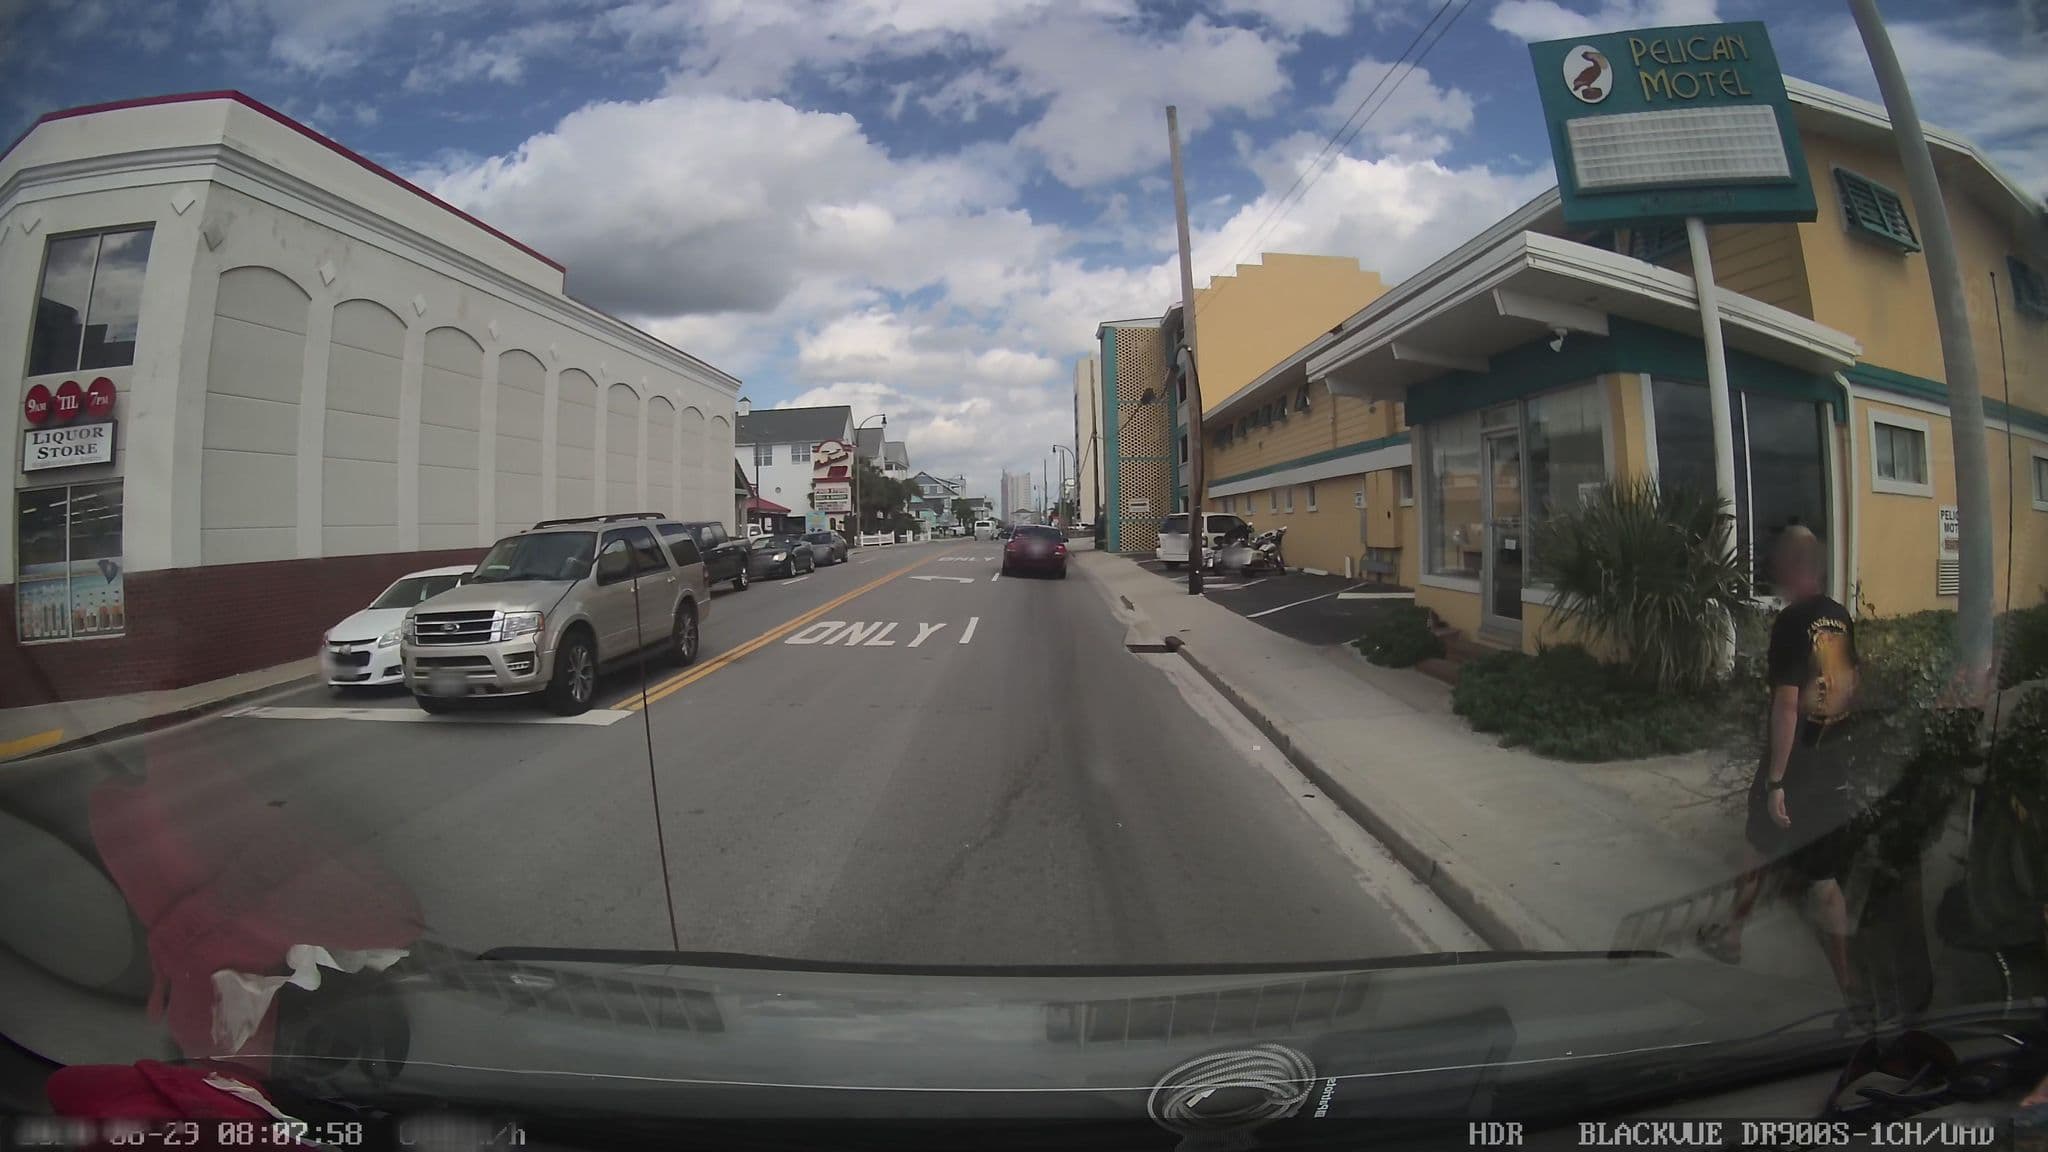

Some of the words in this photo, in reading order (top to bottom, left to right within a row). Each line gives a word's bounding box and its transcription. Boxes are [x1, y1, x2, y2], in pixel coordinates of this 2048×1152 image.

[1628, 35, 1750, 67] PELICAN
[1639, 67, 1752, 101] MOTEL
[27, 399, 47, 413] 9AM
[90, 391, 109, 407] 7PM
[32, 427, 105, 445] LIQUOR
[37, 443, 98, 460] STORE
[784, 621, 948, 648] ONLY
